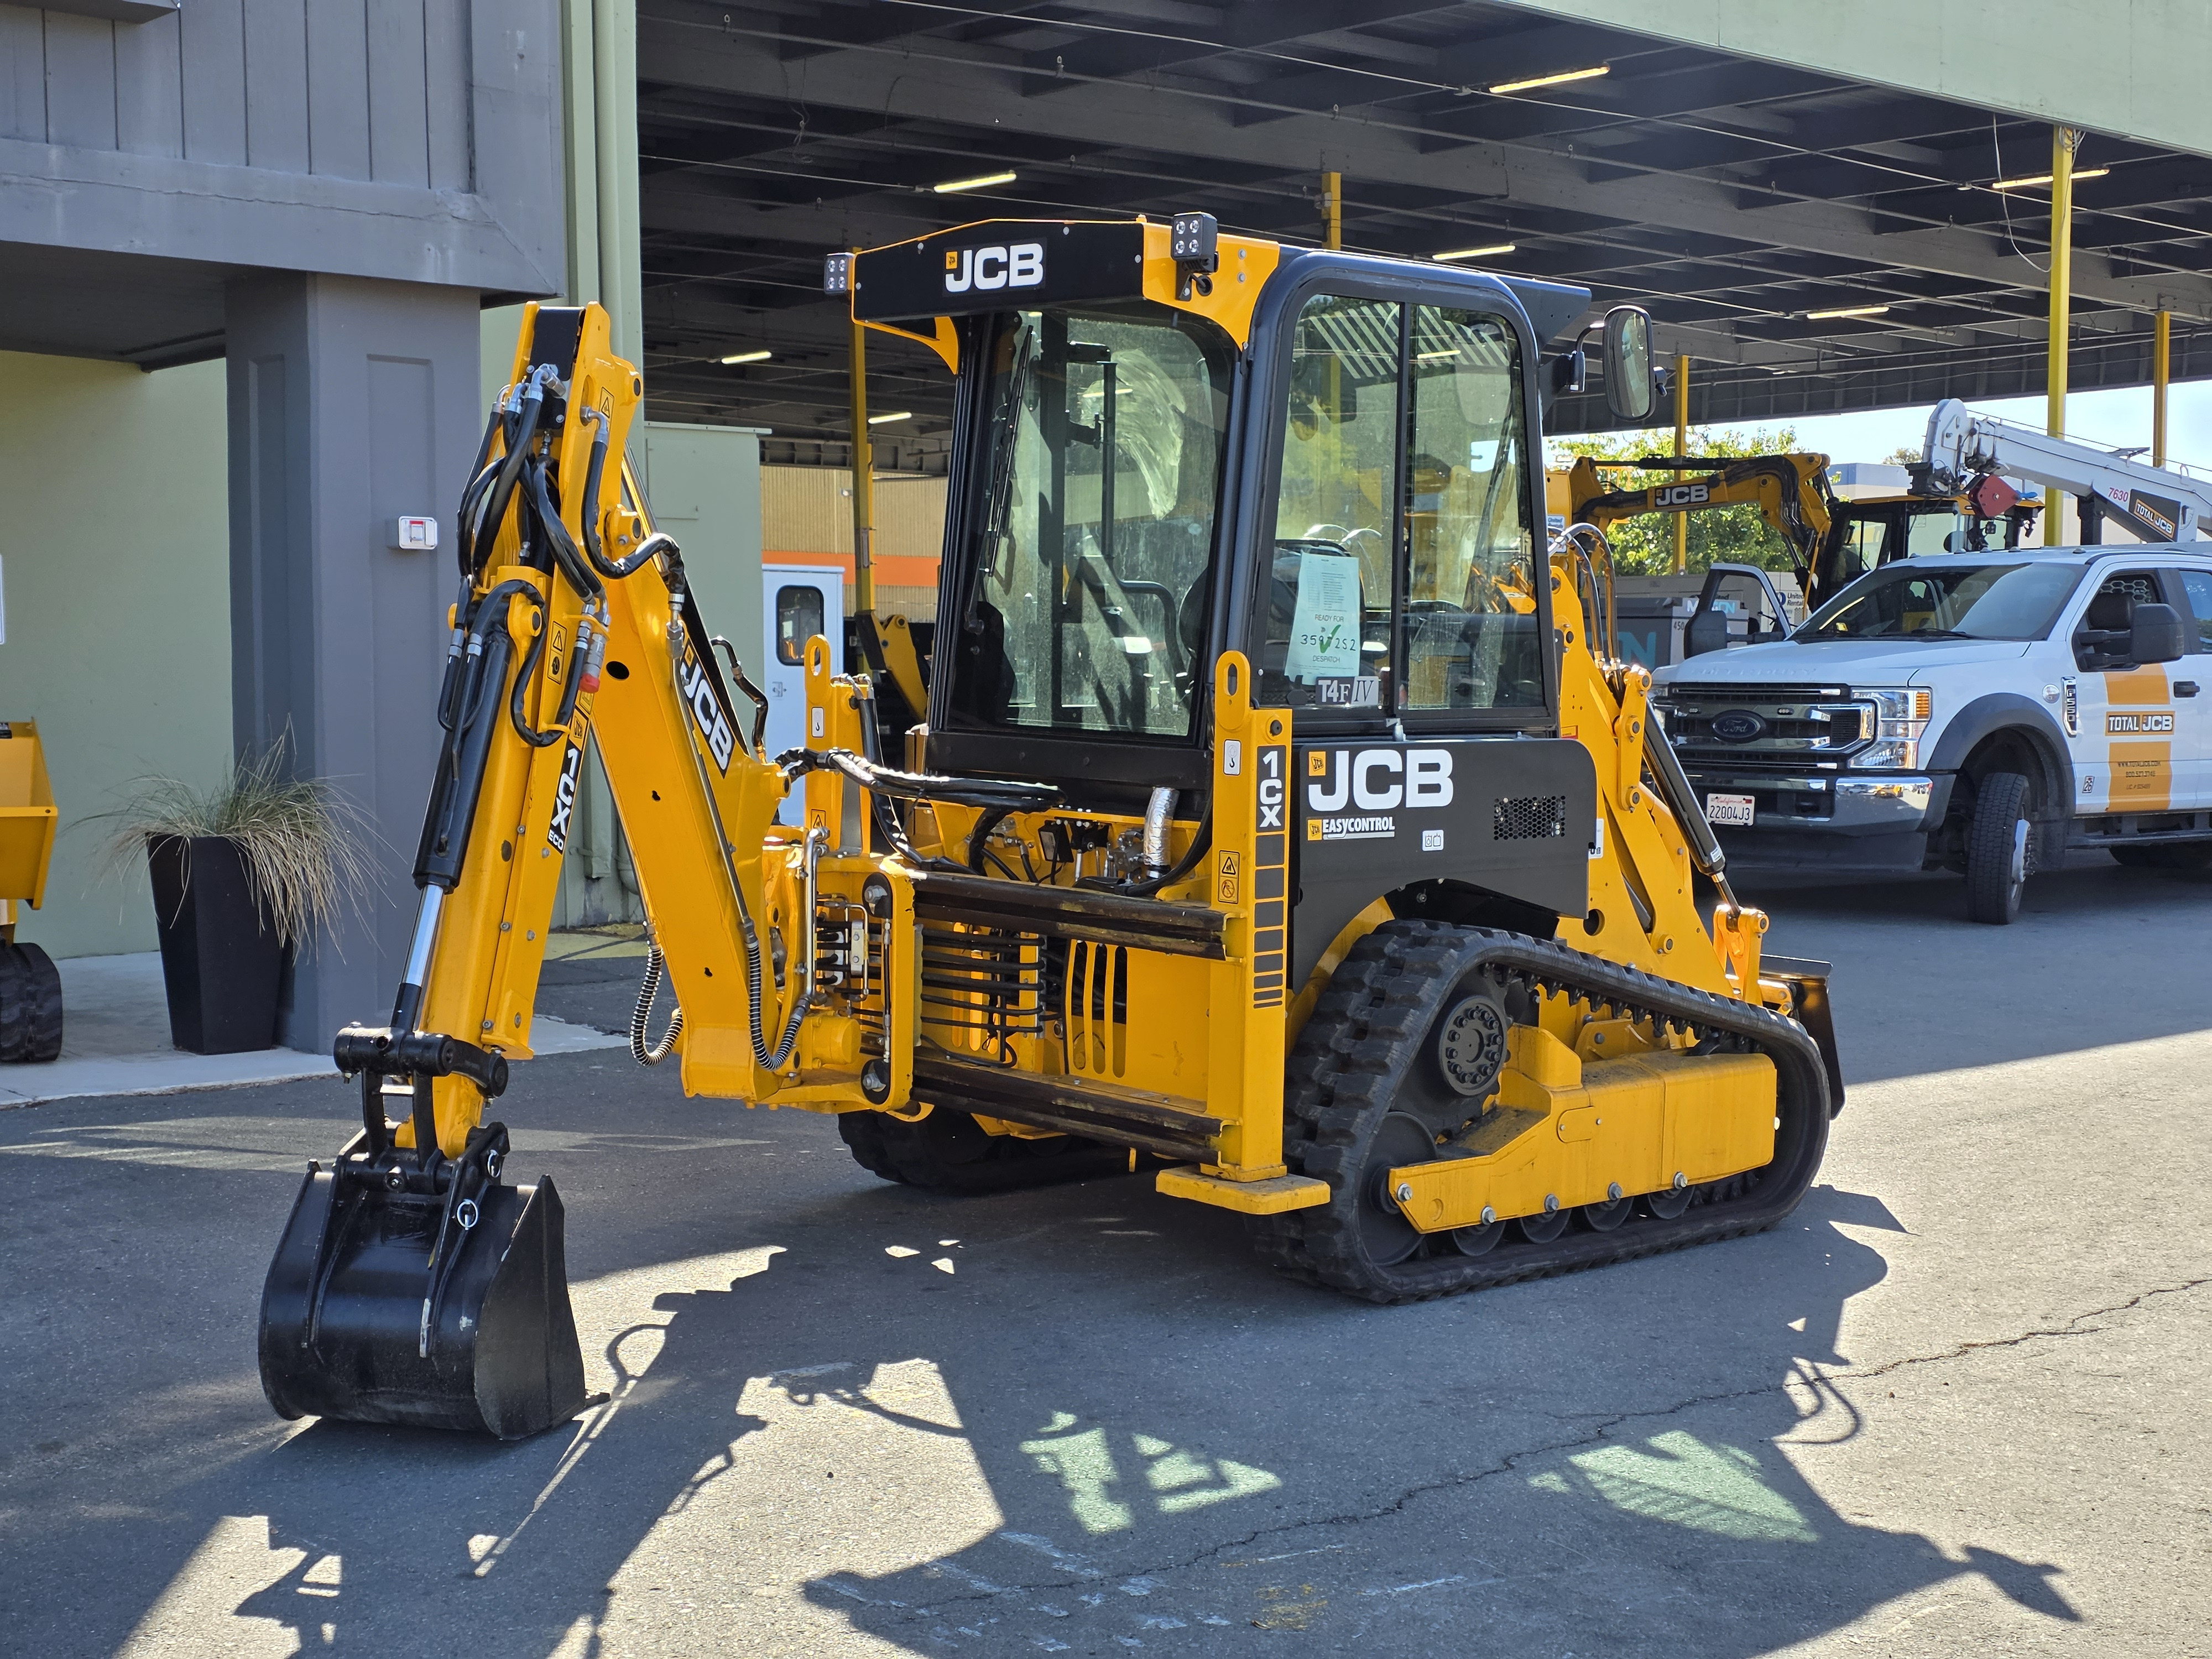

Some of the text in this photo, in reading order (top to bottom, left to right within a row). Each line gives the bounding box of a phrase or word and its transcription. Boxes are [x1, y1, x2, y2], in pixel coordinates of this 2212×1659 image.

[946, 243, 1044, 293] JCB
[1656, 484, 1709, 506] JCB
[2108, 487, 2129, 502] 7630
[2137, 503, 2173, 534] TOTAL JCB
[1314, 614, 1344, 623] READY FOR
[1312, 655, 1340, 664] DESPATCH
[680, 662, 732, 770] JCB
[1723, 719, 1749, 733] Ford
[2109, 716, 2173, 731] TOTAL JCB
[1259, 750, 1282, 828] 1CX
[1308, 749, 1454, 811] JCB
[551, 748, 579, 837] 1CX
[1709, 805, 1750, 821] 22004J3
[1322, 817, 1395, 838] EASYCONTROL
[548, 829, 564, 851] ECO
